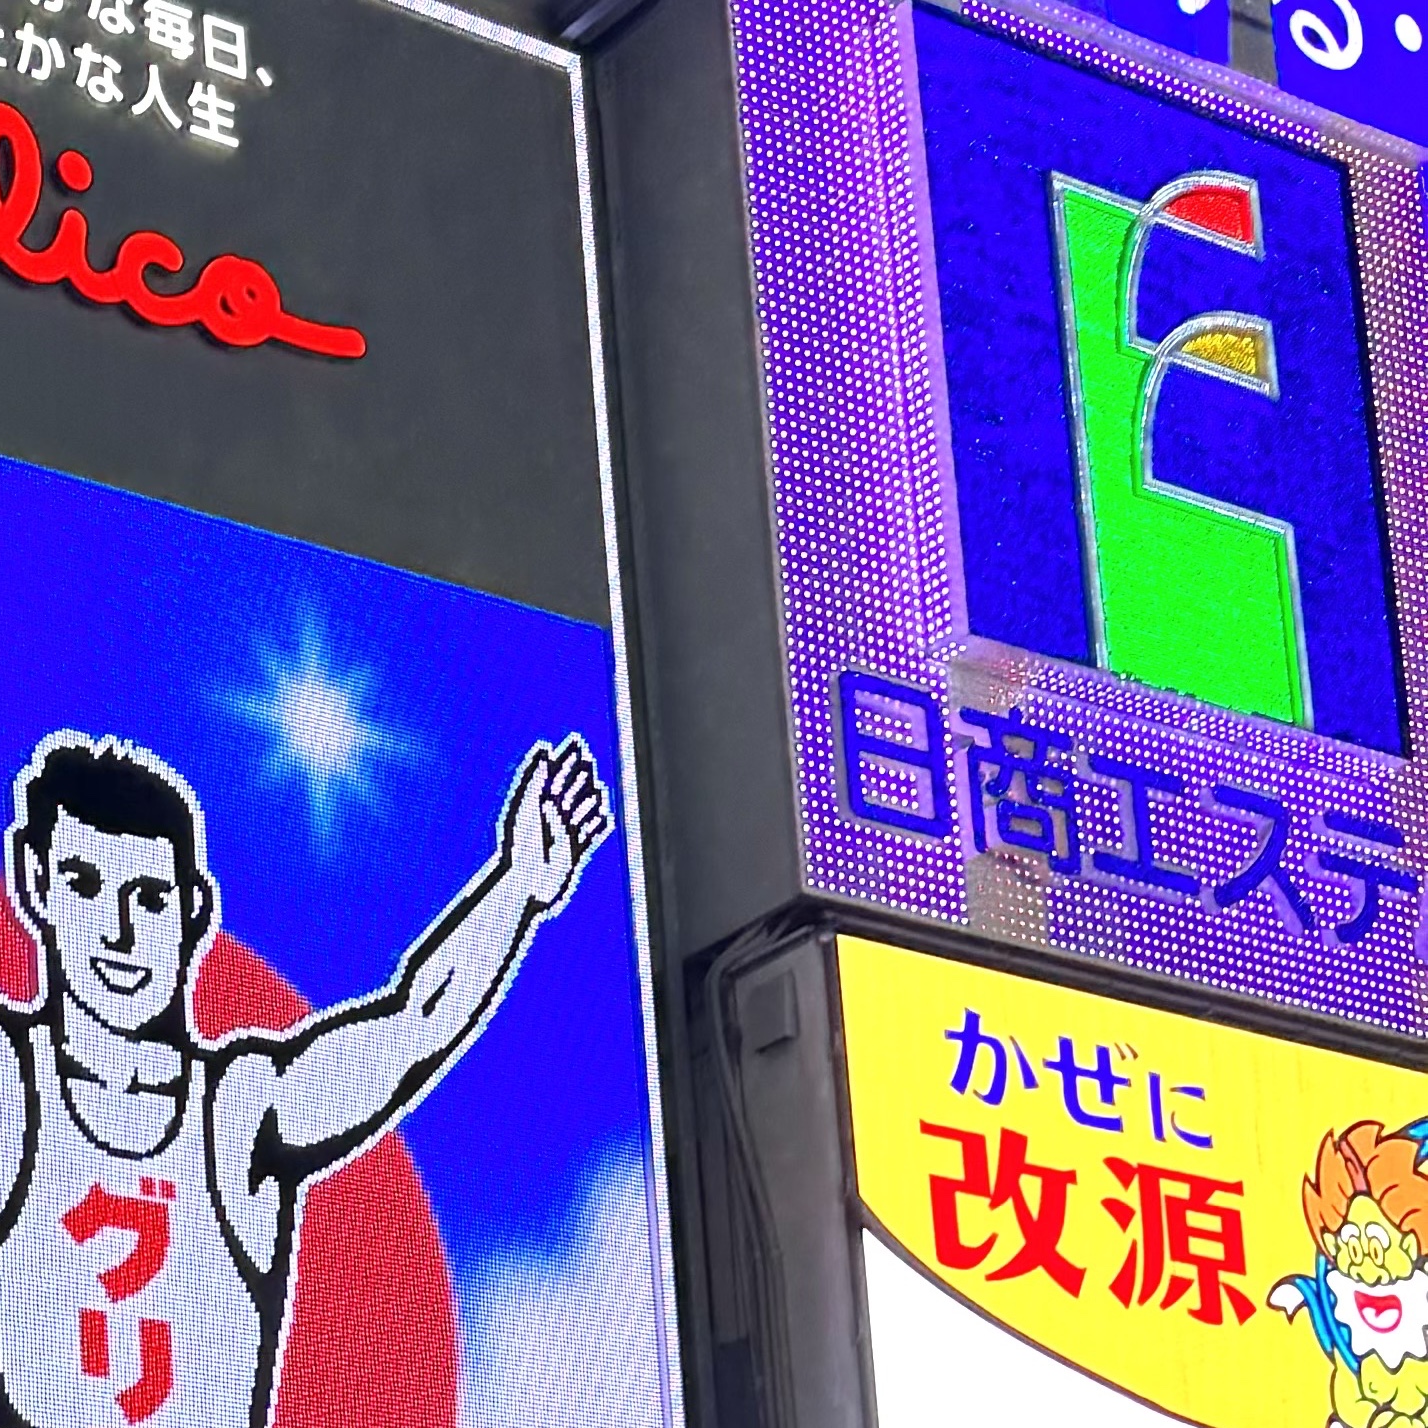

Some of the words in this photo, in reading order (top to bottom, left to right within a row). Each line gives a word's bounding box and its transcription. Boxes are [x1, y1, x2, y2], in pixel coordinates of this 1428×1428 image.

[33, 0, 273, 88] な毎日、
[839, 667, 1421, 946] 日商エステ
[944, 1007, 1215, 1149] かぜに
[919, 1118, 1257, 1326] 改源
